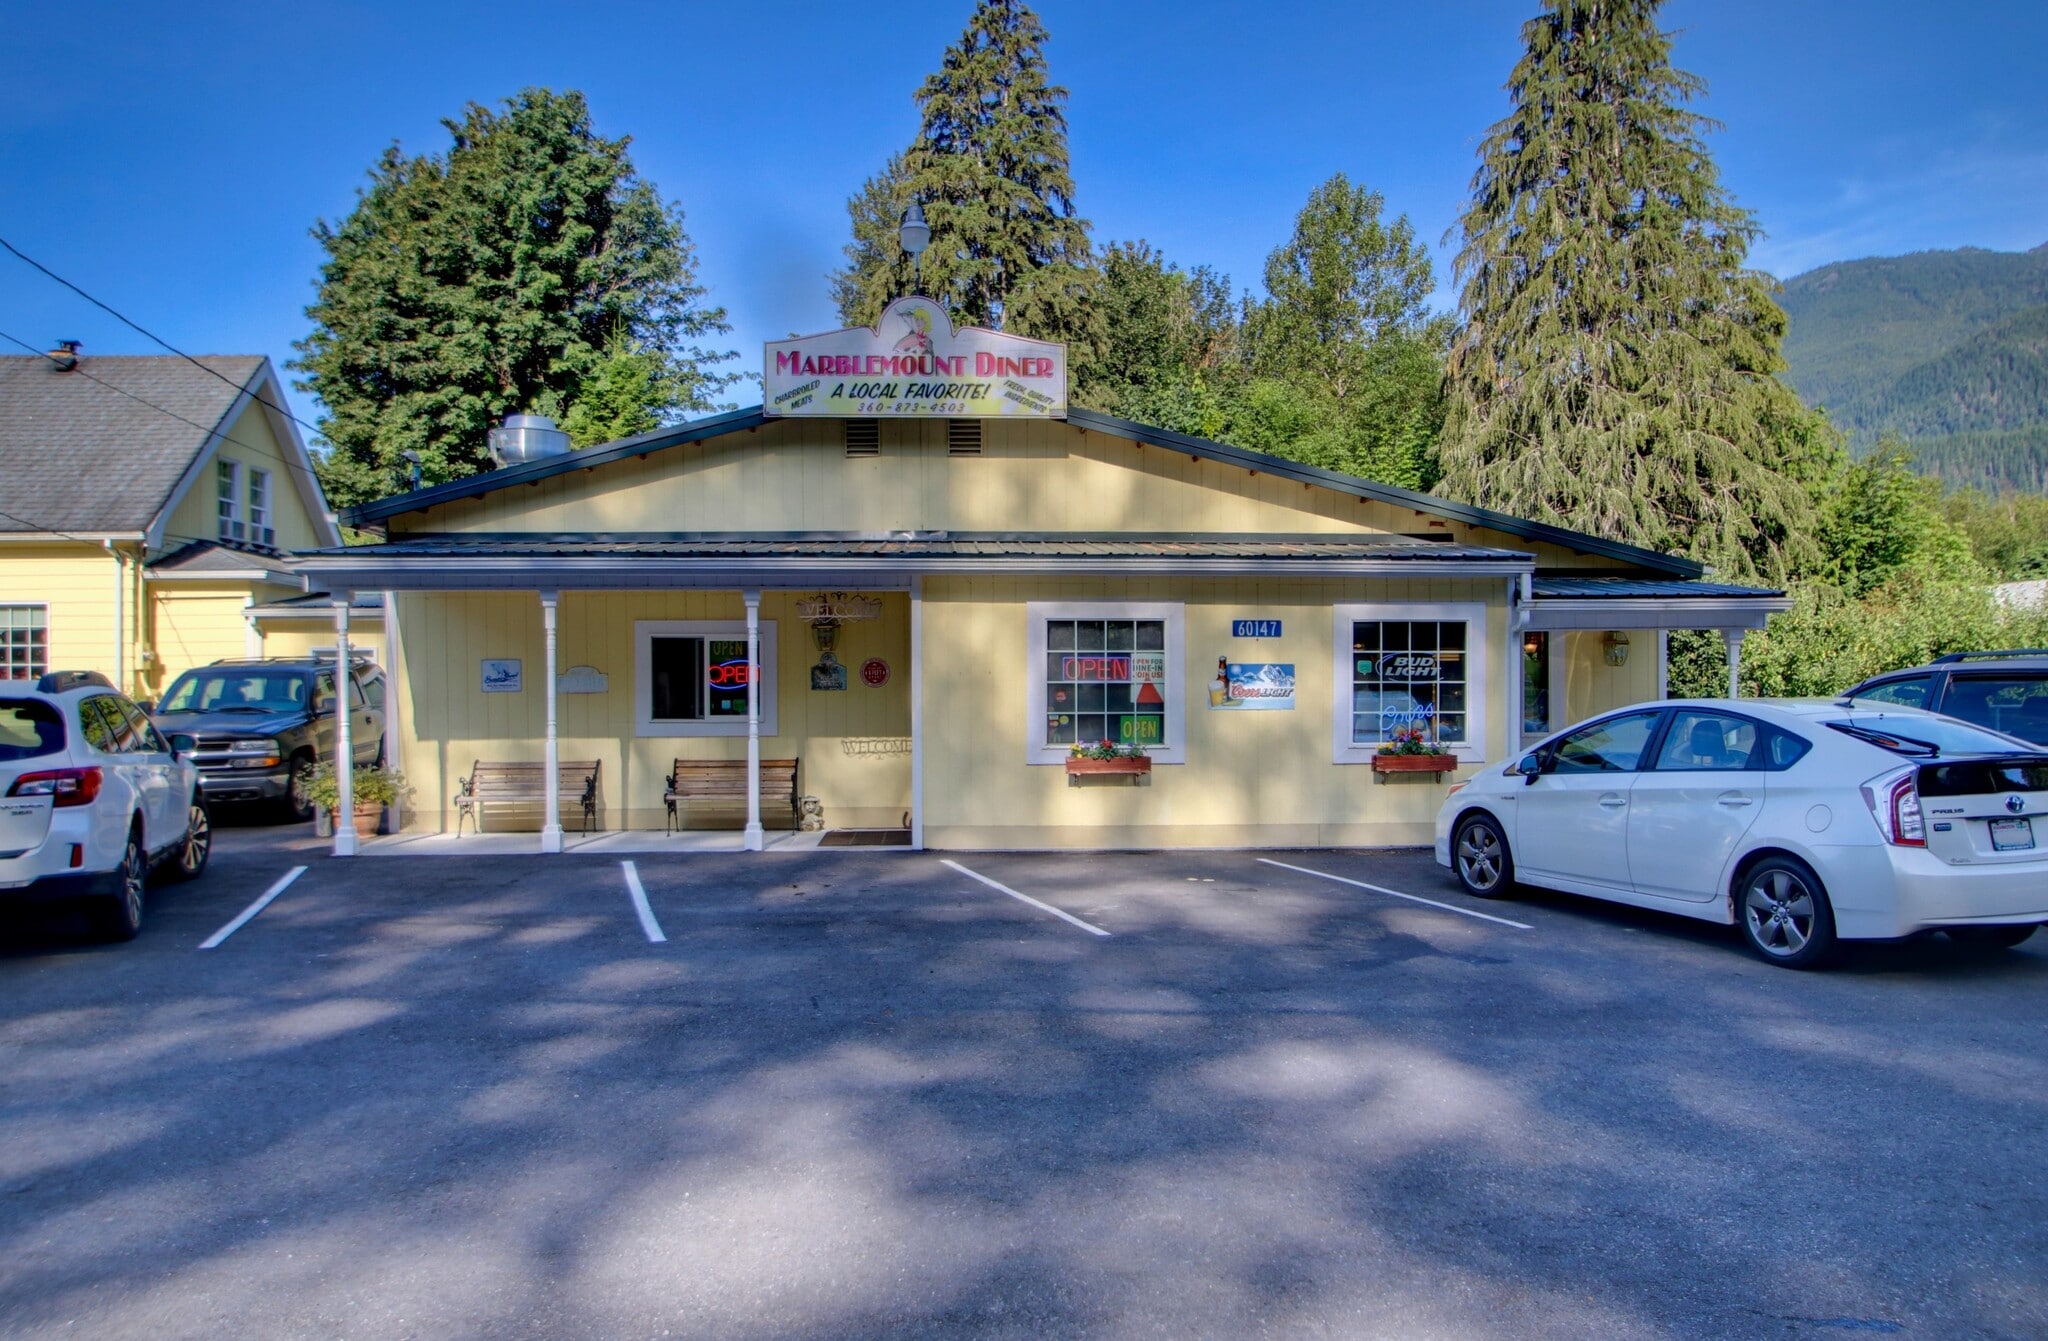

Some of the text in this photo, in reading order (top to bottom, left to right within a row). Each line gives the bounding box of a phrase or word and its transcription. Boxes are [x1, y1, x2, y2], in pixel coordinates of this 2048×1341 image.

[776, 351, 1054, 378] MARBLEMOUNT DINER
[775, 380, 820, 405] CHARBROILED
[831, 383, 991, 400] A LOCAL FAVORITE!
[1027, 389, 1055, 405] QUALITY
[791, 394, 813, 410] MEATS
[858, 402, 965, 413] 360-873-4503
[1003, 391, 1047, 413] INGREDIENTS
[1238, 621, 1277, 636] 60147
[713, 641, 743, 655] OPEN
[1065, 659, 1128, 679] OPEN
[1394, 657, 1434, 667] BUD
[1385, 667, 1441, 676] LIGHT
[1231, 684, 1294, 698] Coors LIGHT
[1123, 721, 1156, 737] OPEN
